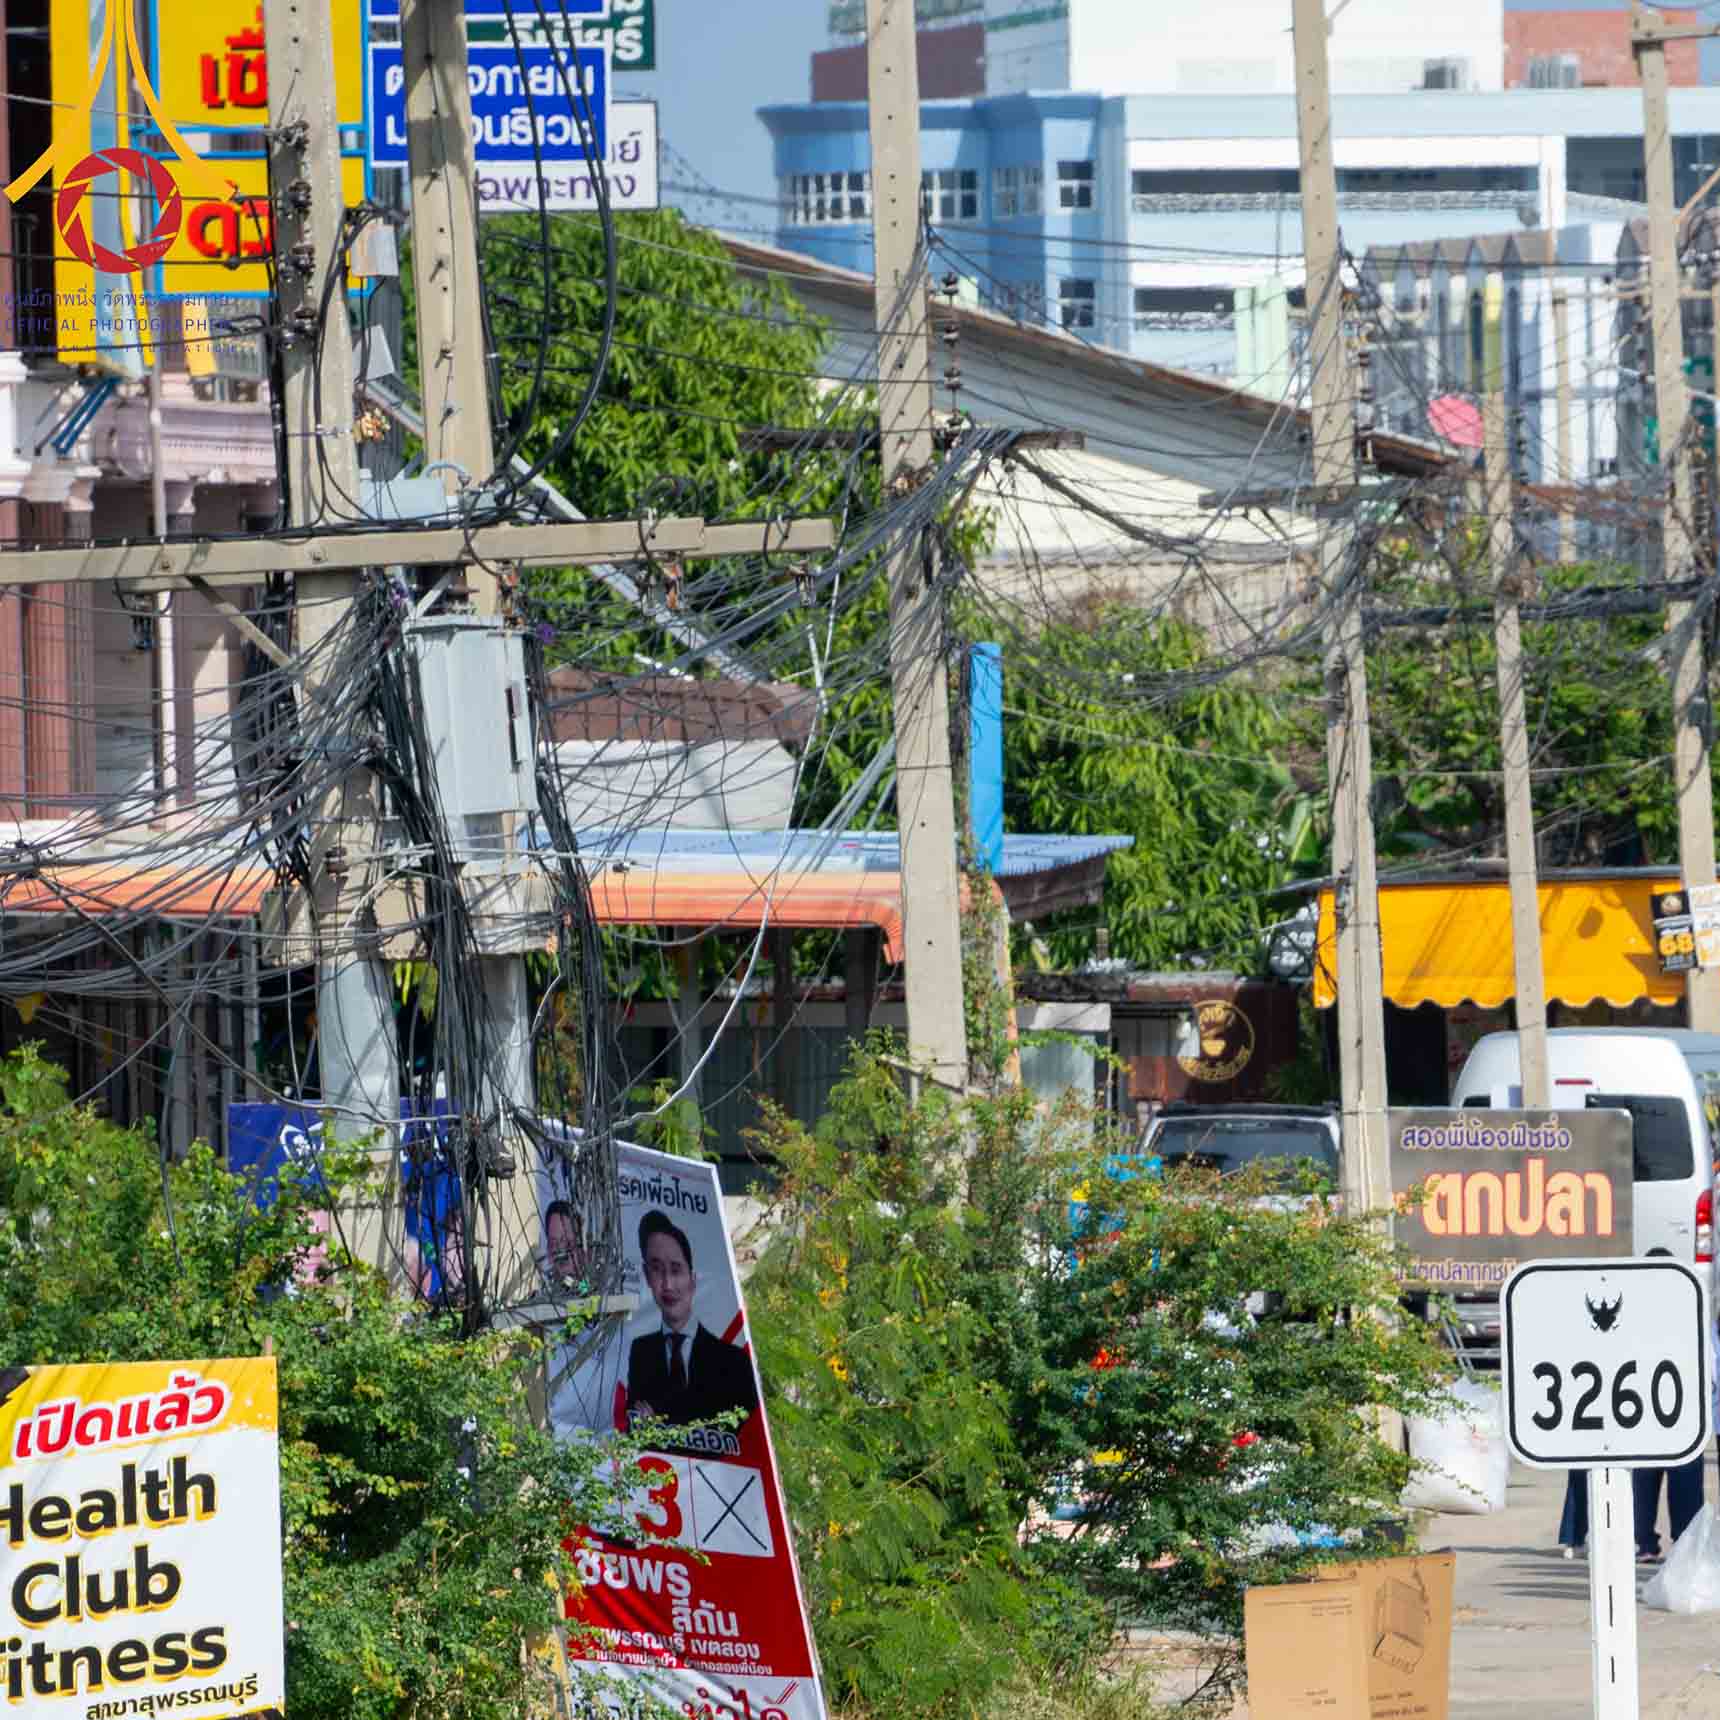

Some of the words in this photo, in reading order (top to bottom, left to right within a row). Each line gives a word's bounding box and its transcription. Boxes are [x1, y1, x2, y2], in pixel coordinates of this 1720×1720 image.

[1422, 1156, 1614, 1236] ตกปลา
[14, 1375, 226, 1459] เปิดแล้ว
[1531, 1359, 1685, 1431] 3260
[11, 1544, 182, 1625] Club
[0, 1626, 228, 1701] itness
[86, 1674, 259, 1720] สาขาสุพรรณบุรี
